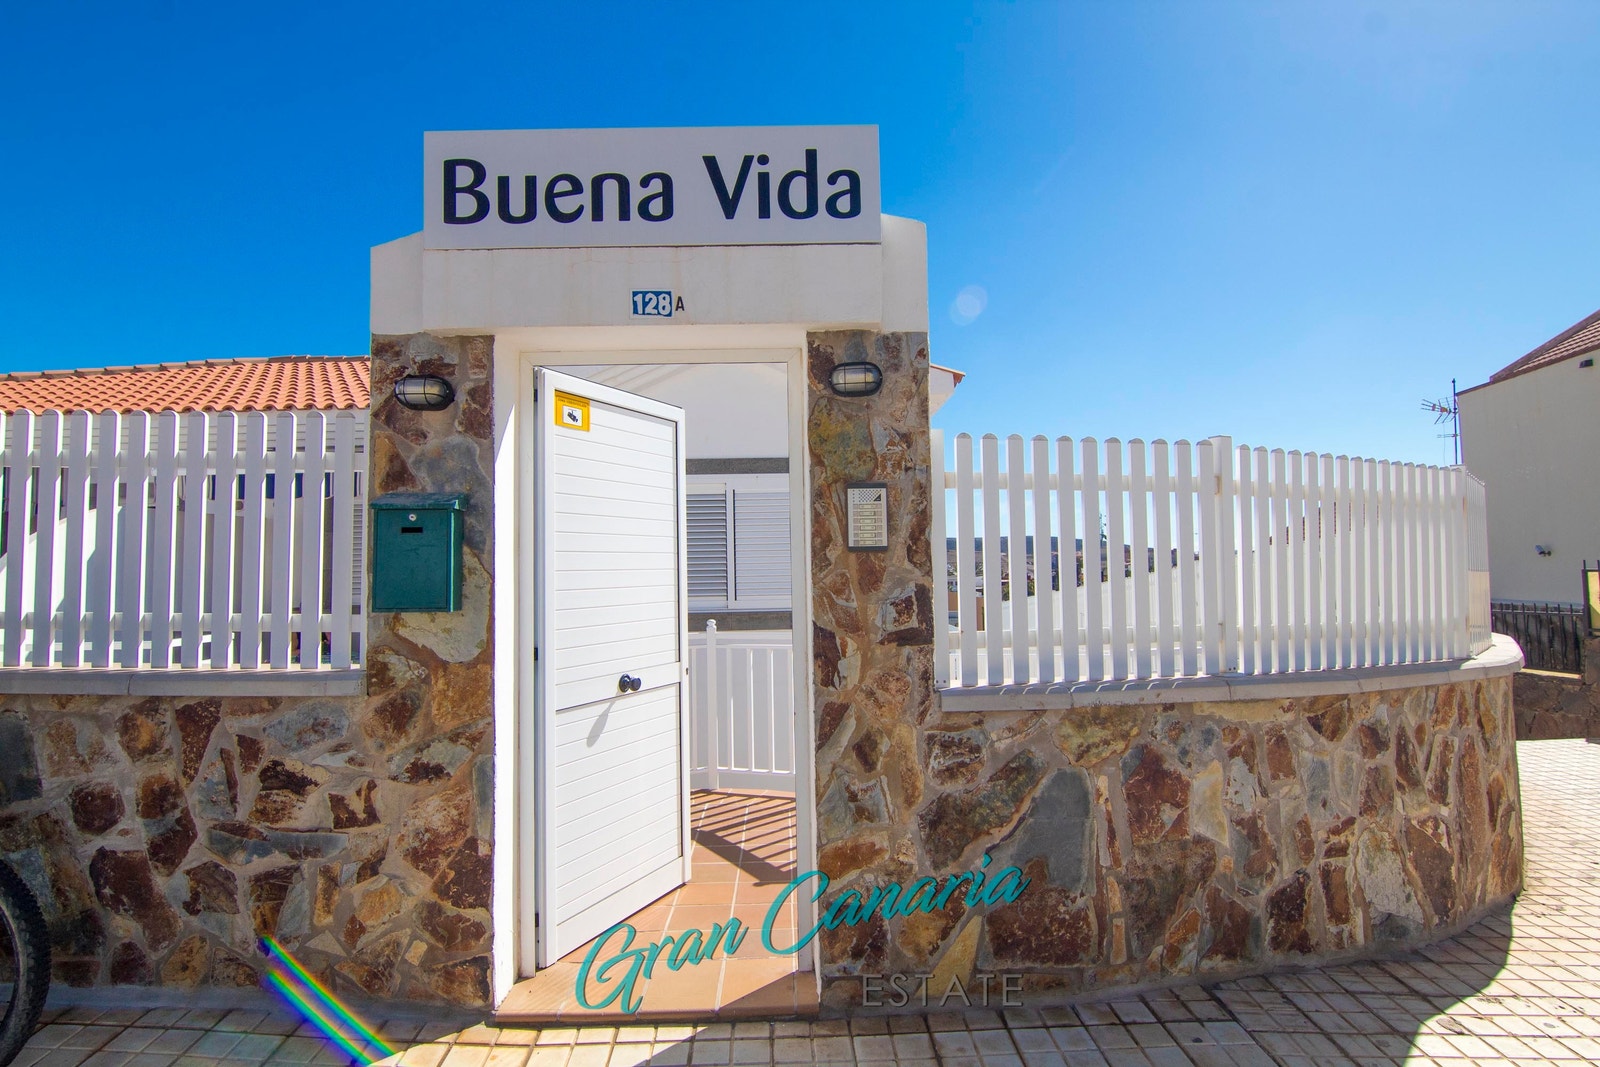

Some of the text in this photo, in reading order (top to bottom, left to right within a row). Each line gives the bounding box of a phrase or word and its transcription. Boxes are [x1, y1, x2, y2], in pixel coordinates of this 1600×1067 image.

[443, 148, 862, 225] Buena Vida
[633, 292, 685, 316] 128 A
